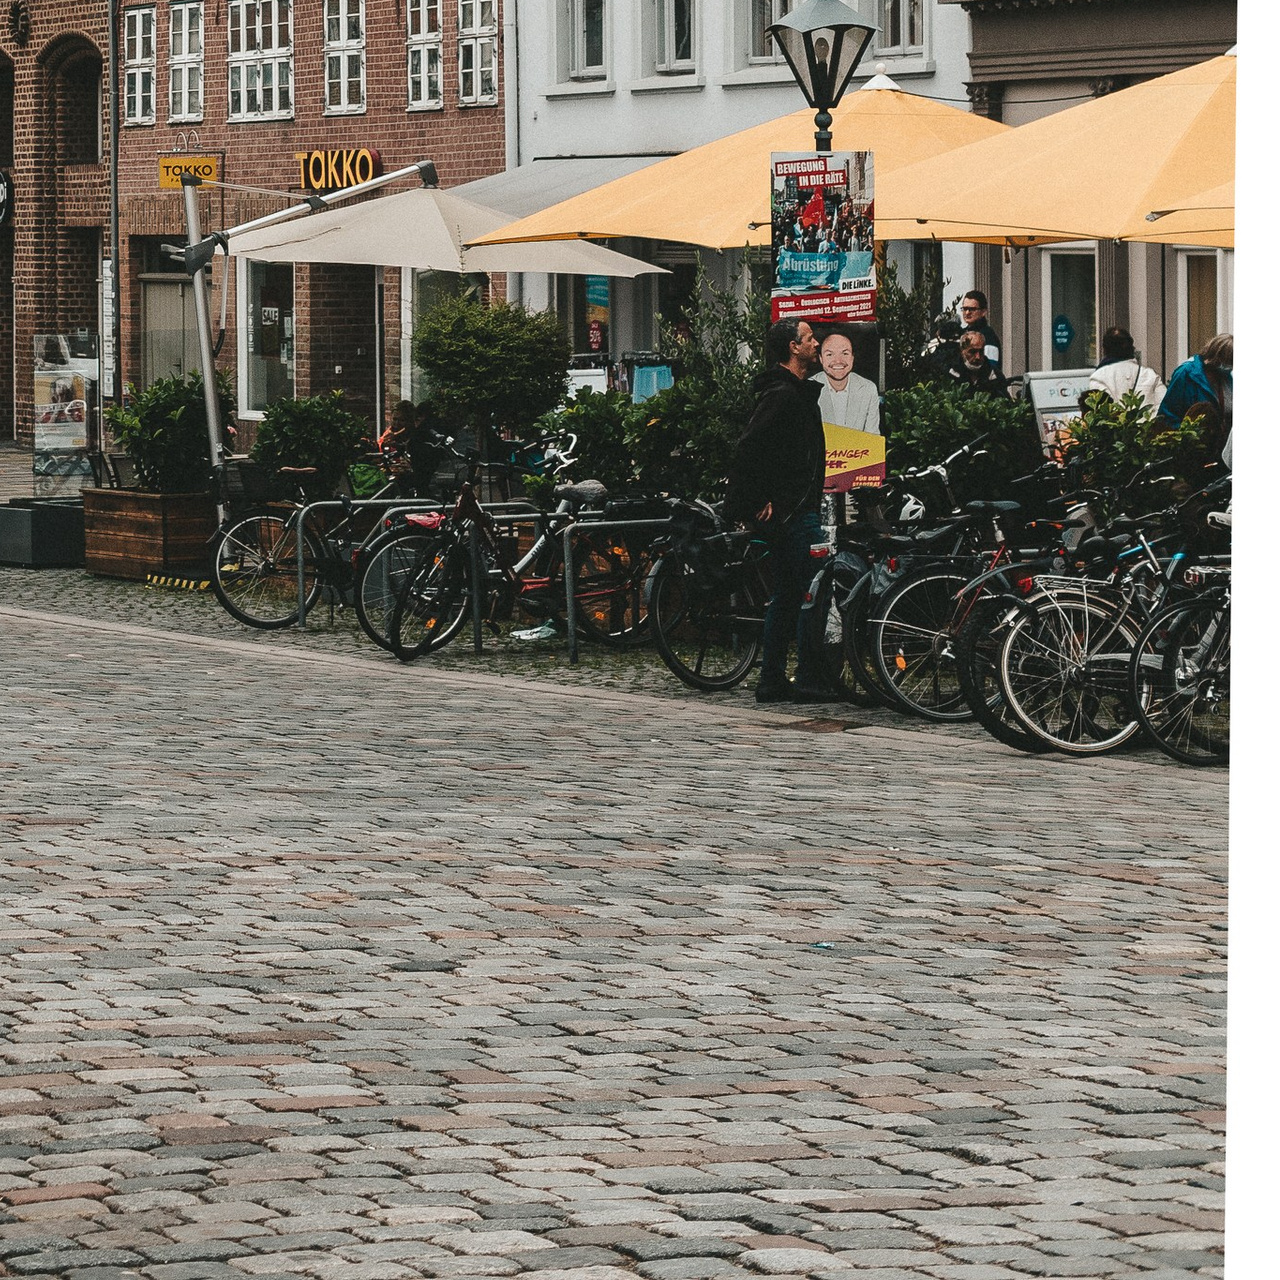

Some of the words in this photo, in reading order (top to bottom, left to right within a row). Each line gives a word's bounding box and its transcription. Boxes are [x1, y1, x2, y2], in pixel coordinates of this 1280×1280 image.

[776, 160, 825, 175] BEWEGUNG
[798, 175, 809, 187] IN
[810, 174, 824, 186] DIE
[825, 171, 844, 184] RÄTE
[782, 257, 839, 272] Abrüstung
[842, 281, 853, 290] DIE
[263, 309, 278, 320] SALE
[824, 306, 832, 314] 12.
[832, 303, 860, 314] September
[859, 301, 872, 310] 2021
